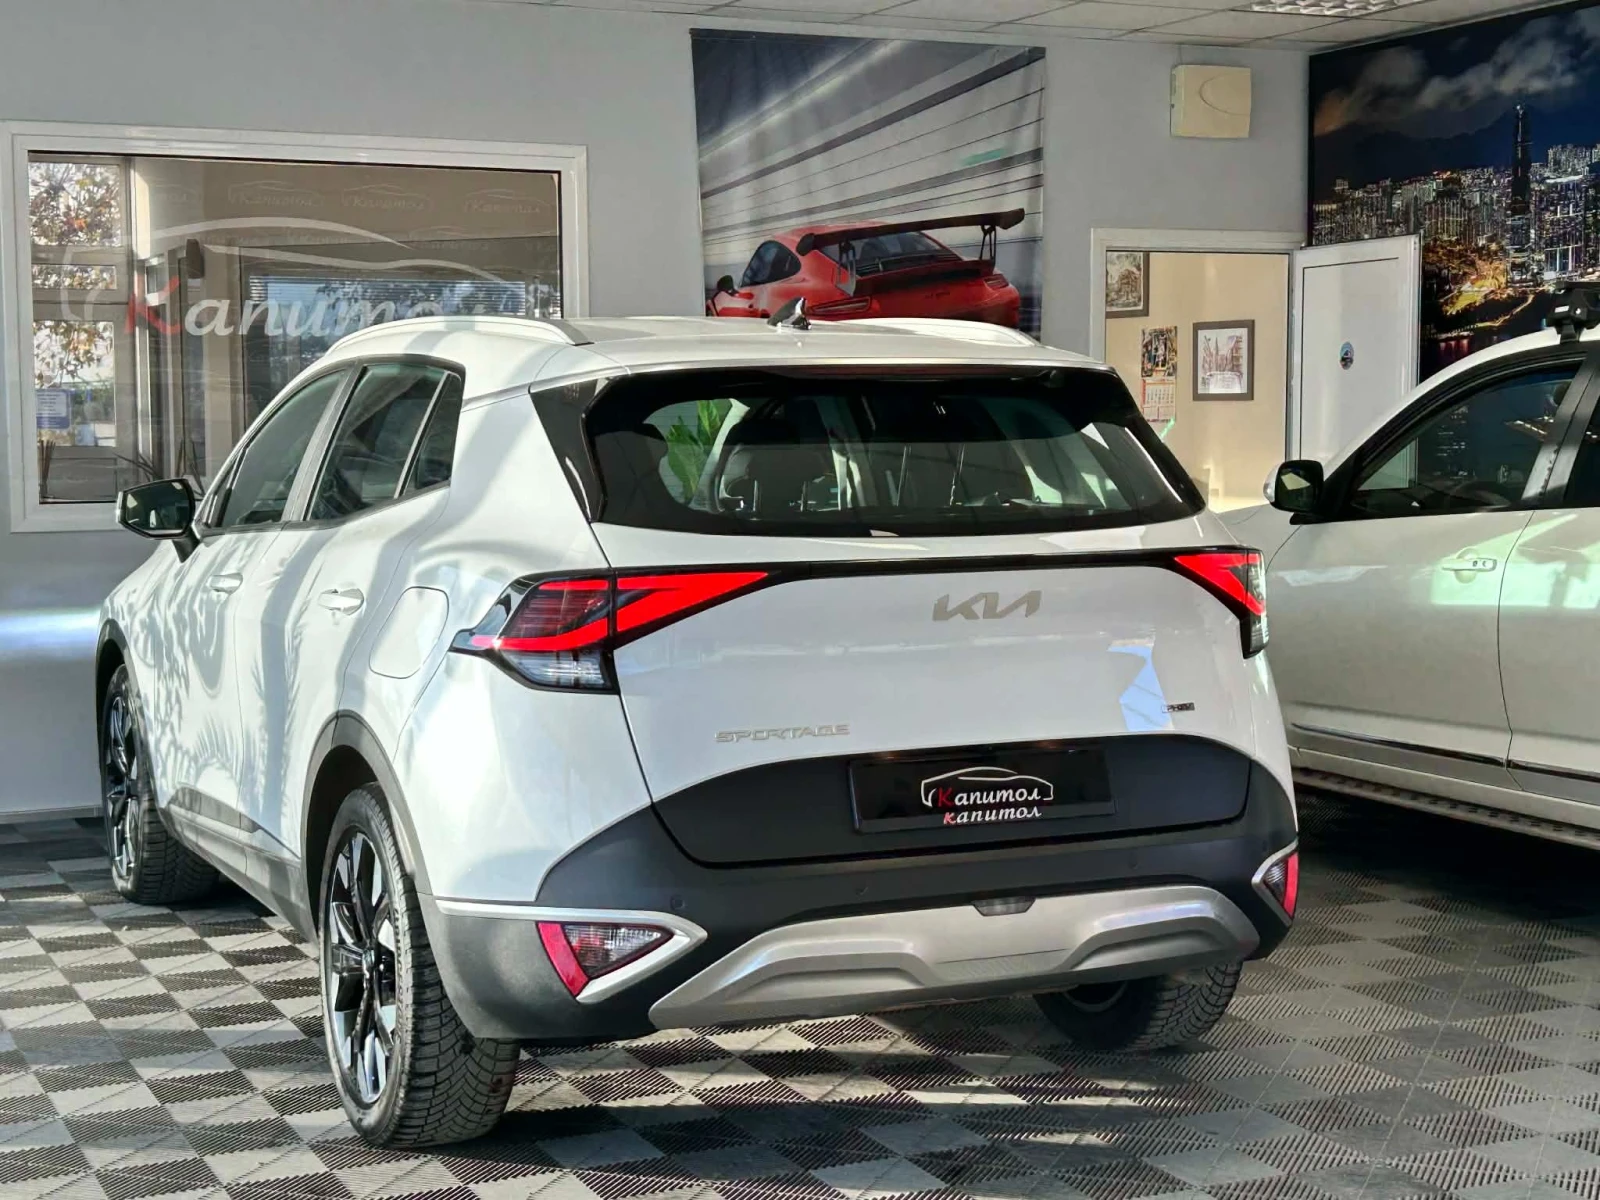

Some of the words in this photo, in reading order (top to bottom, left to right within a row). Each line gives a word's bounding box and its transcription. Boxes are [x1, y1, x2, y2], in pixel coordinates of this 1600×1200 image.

[124, 275, 487, 338] Капит
[932, 590, 1042, 621] KIA
[714, 724, 850, 742] SPORTAGE
[938, 787, 1041, 807] Капитол
